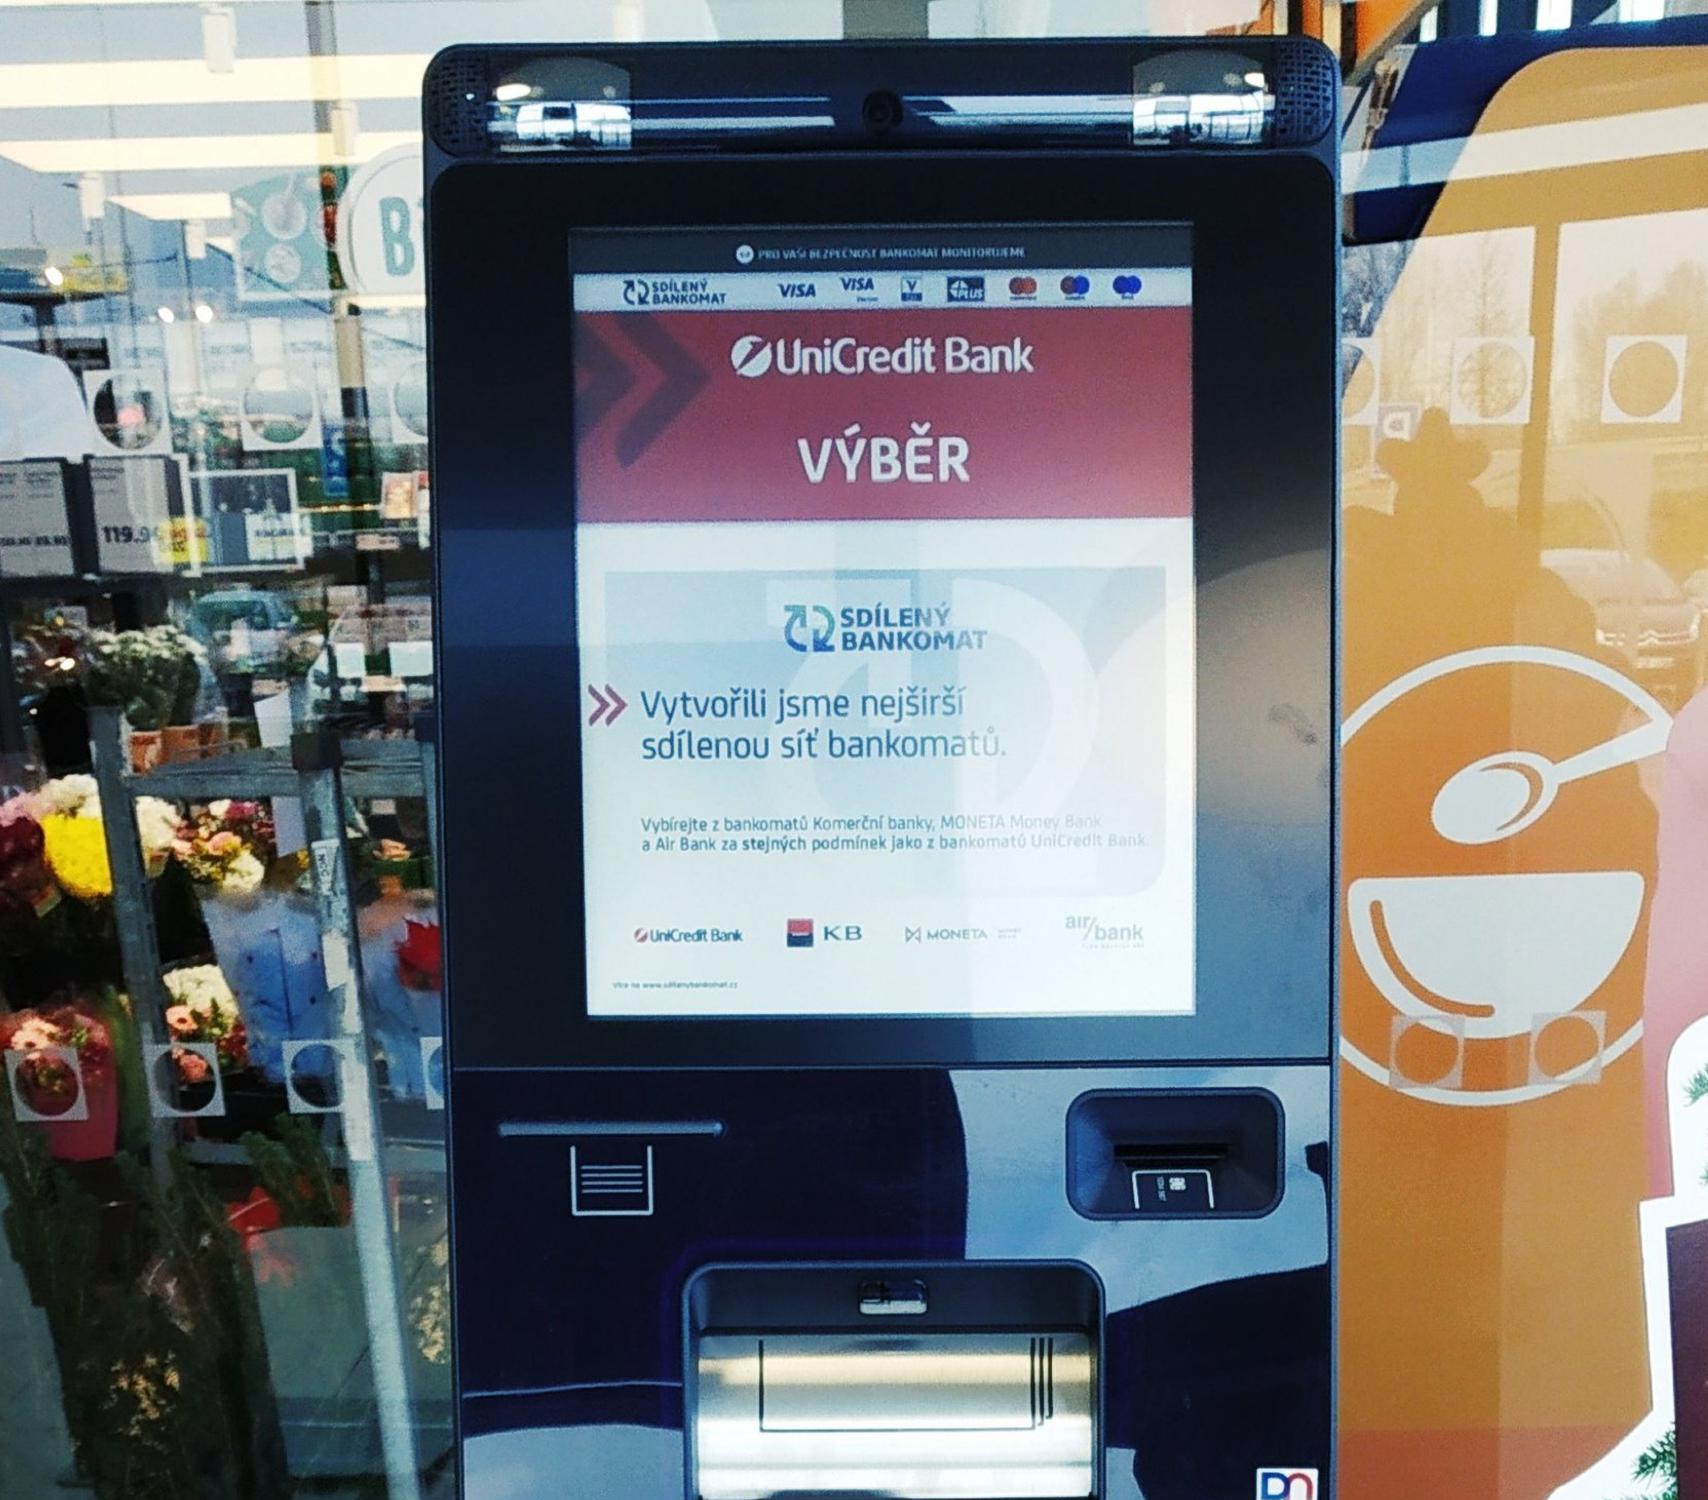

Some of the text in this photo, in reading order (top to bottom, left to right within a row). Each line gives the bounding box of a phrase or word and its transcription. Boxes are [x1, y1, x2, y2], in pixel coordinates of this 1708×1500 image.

[879, 246, 939, 259] BANKOMAT
[941, 245, 1025, 259] MONITORUJEME
[651, 278, 709, 293] SDÍLENÝ
[778, 282, 817, 298] VISA
[840, 276, 875, 291] VISA
[652, 292, 727, 305] BANKOMAT
[776, 336, 1035, 375] UniCredit Bank
[797, 421, 971, 484] VÝBĚR
[840, 601, 951, 628] SDÍLENÝ
[841, 630, 988, 651] BANKOMAT
[640, 685, 967, 726] Vytvořili jsme nejširší
[642, 725, 1007, 760] sdílenou síť bankomatů.
[641, 813, 1103, 836] Vybírejte z bankomatů Komerční banky, MONETA Money Bank
[641, 839, 650, 852] a
[655, 836, 676, 852] Air
[680, 836, 717, 852] Bank
[721, 839, 738, 851] za
[742, 834, 807, 854] stejných
[812, 834, 887, 854] podmínek
[891, 834, 923, 853] jako
[927, 837, 935, 850] z
[939, 832, 1027, 850] bankomatů
[1031, 832, 1103, 849] UniCredit
[650, 927, 744, 943] UniCredit Bank
[823, 925, 863, 941] KB
[926, 927, 989, 941] MONETA
